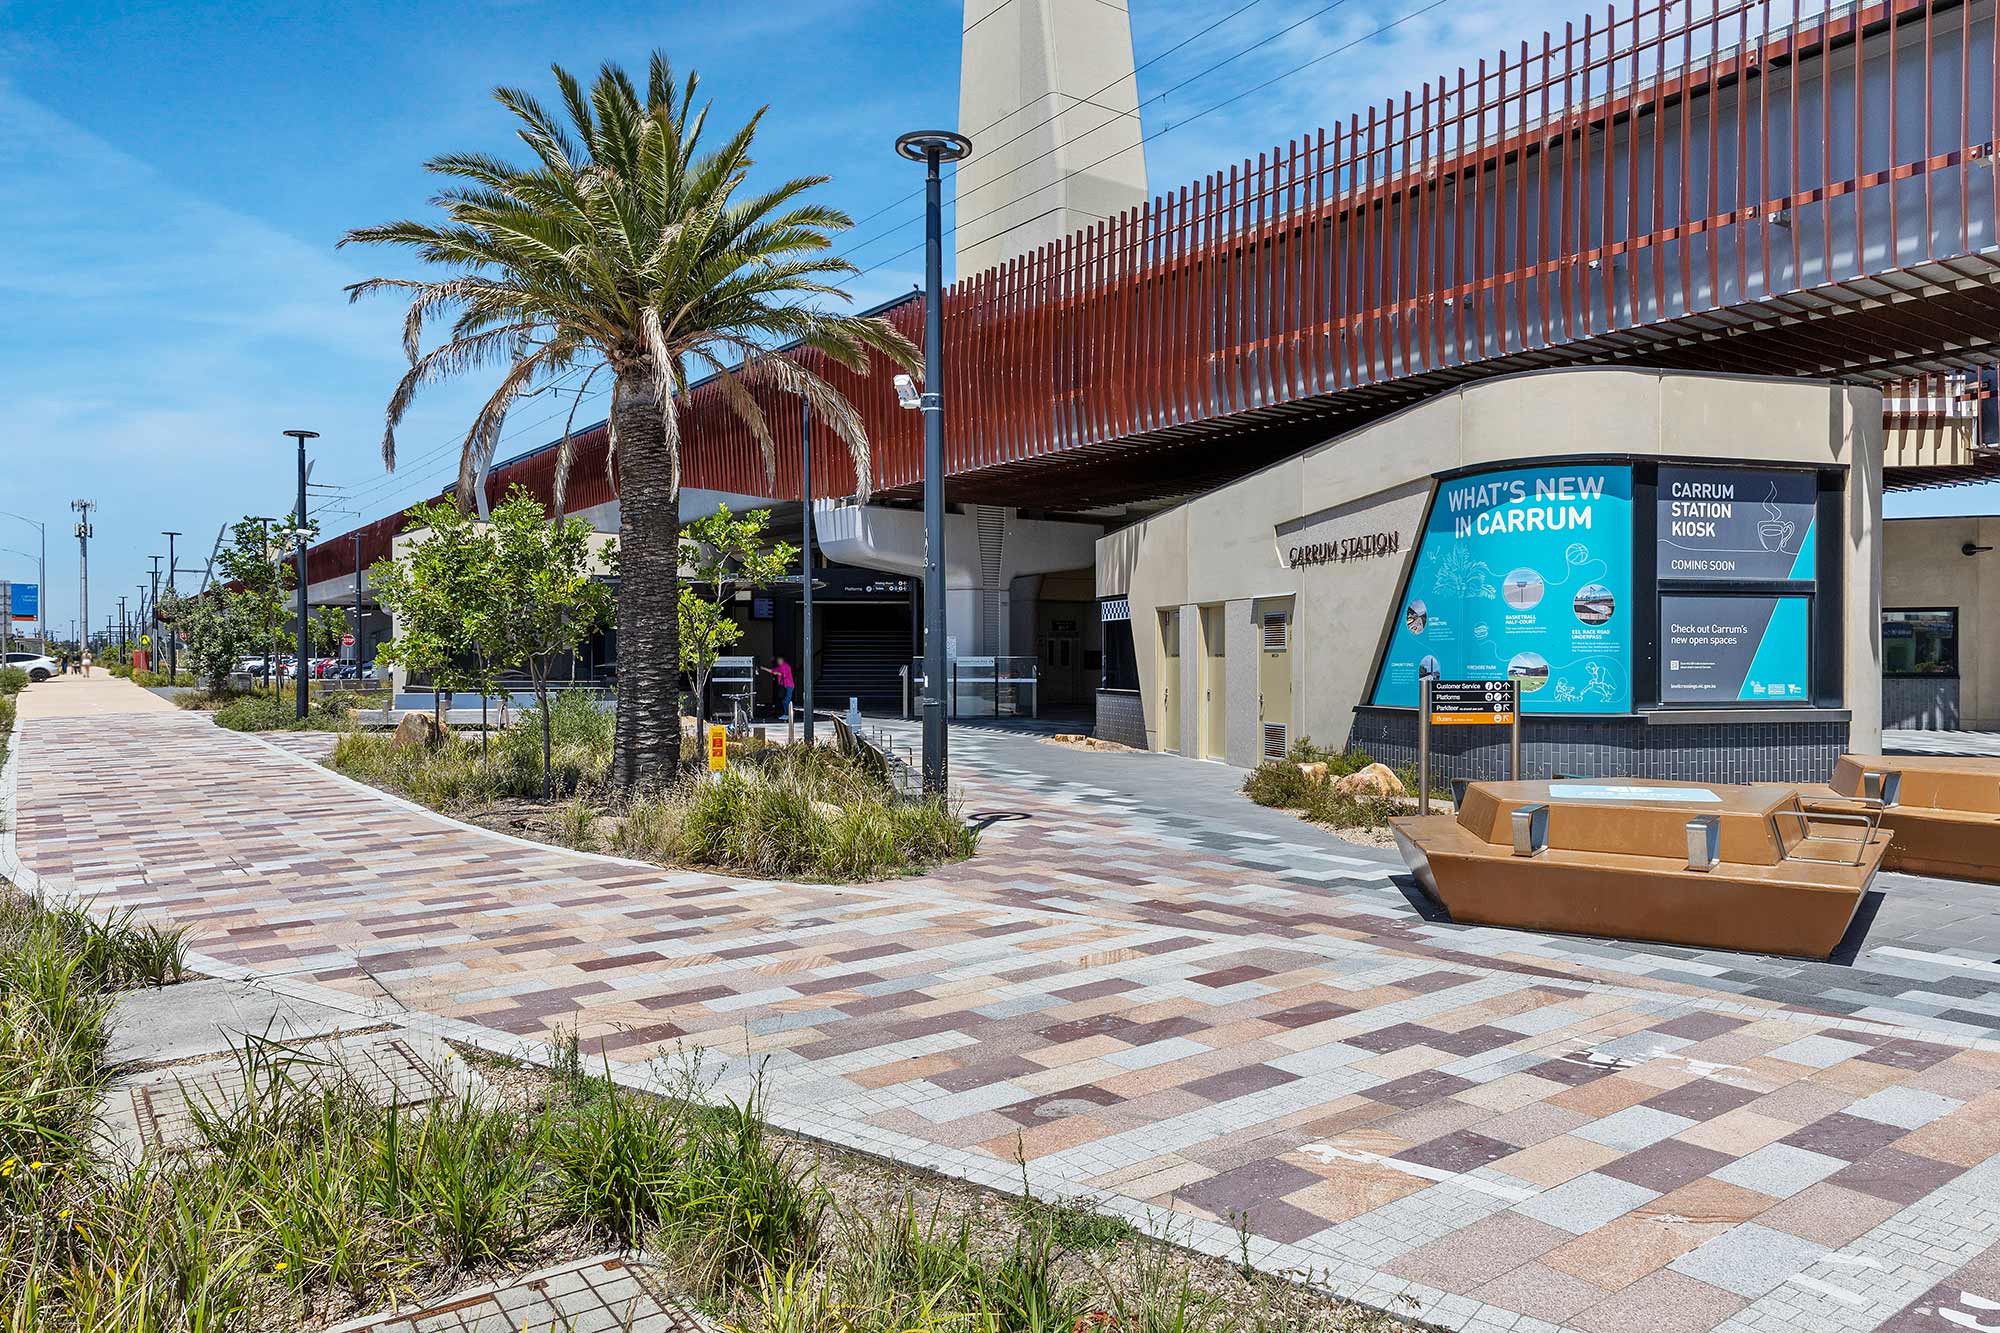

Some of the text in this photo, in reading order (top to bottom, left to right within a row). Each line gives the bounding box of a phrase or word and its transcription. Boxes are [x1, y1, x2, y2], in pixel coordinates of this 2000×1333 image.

[1448, 476, 1605, 513] WHAT'S NEW
[1671, 482, 1735, 499] CARRUM
[1671, 502, 1733, 519] STATION
[1455, 506, 1593, 539] IN CARRUM
[1671, 521, 1716, 537] KIOSK
[1289, 531, 1399, 564] CARRUM STATION
[1671, 559, 1736, 571] COMING SOON
[1670, 623, 1748, 634] Check out Carrum's
[1689, 637, 1709, 646] open
[1710, 637, 1738, 646] spaces
